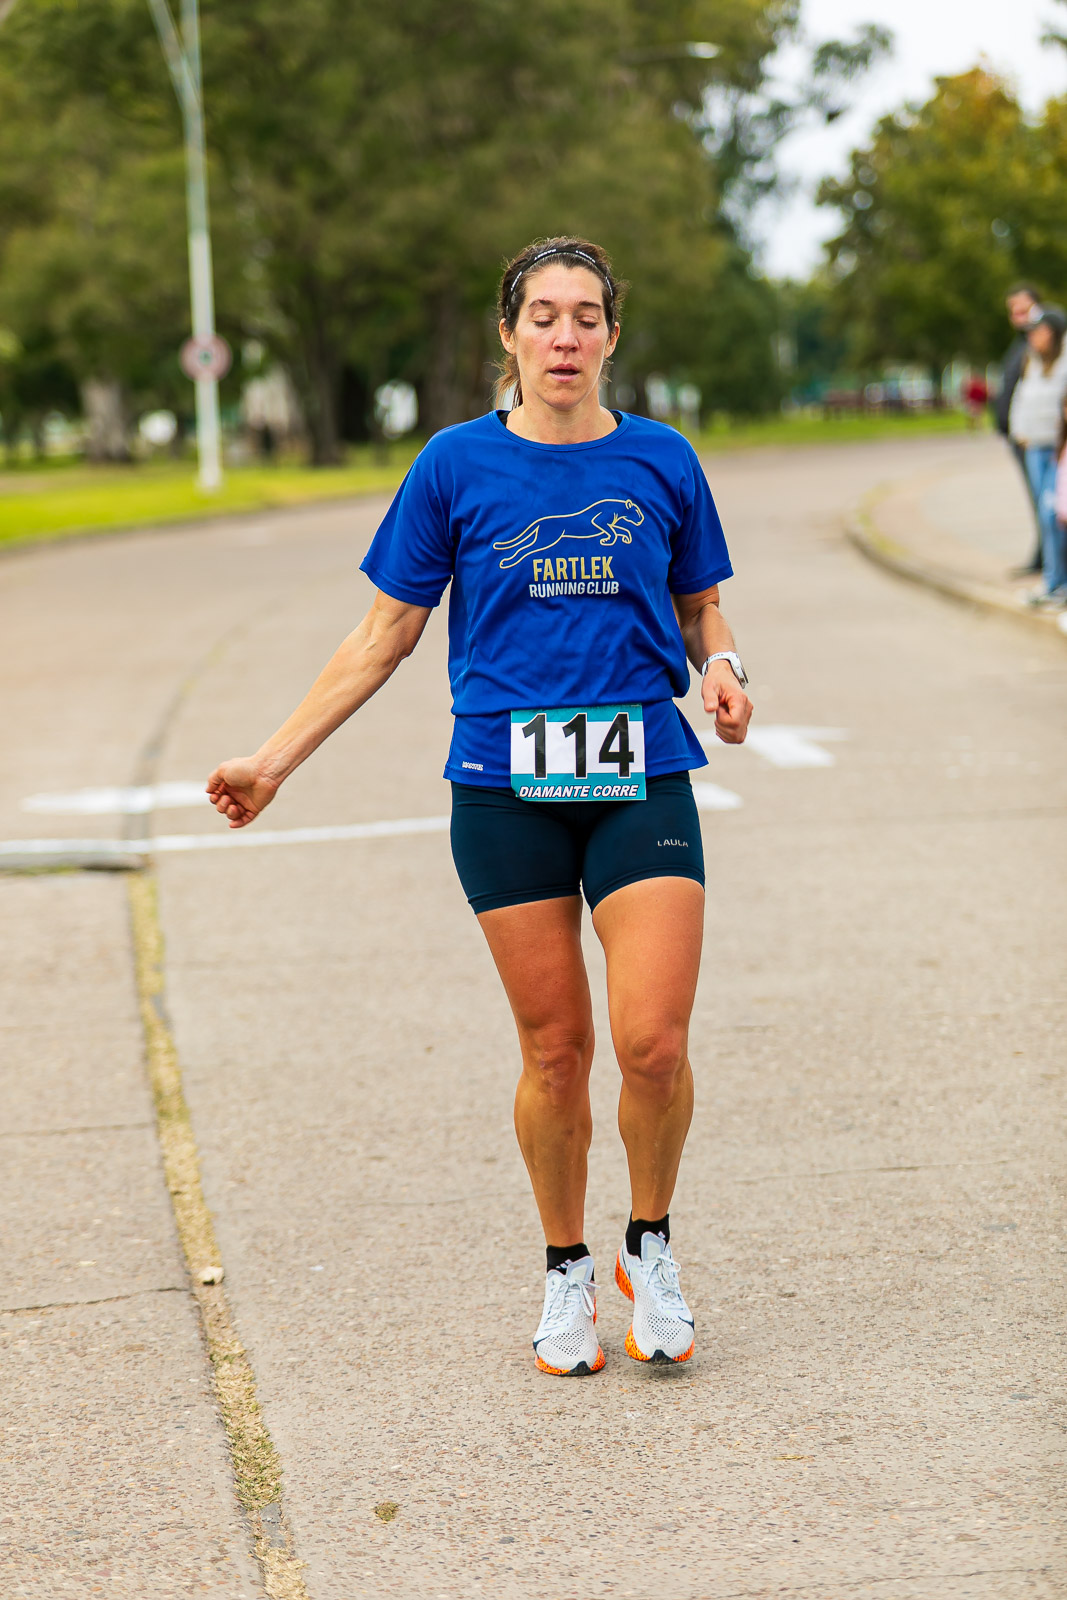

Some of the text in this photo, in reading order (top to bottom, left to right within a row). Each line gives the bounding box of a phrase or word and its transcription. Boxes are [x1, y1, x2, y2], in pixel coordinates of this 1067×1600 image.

[532, 555, 615, 582] FARTLEK
[528, 581, 620, 598] RUNNING CLUB
[521, 712, 635, 779] 114
[518, 784, 639, 798] DIAMANTE CORRE
